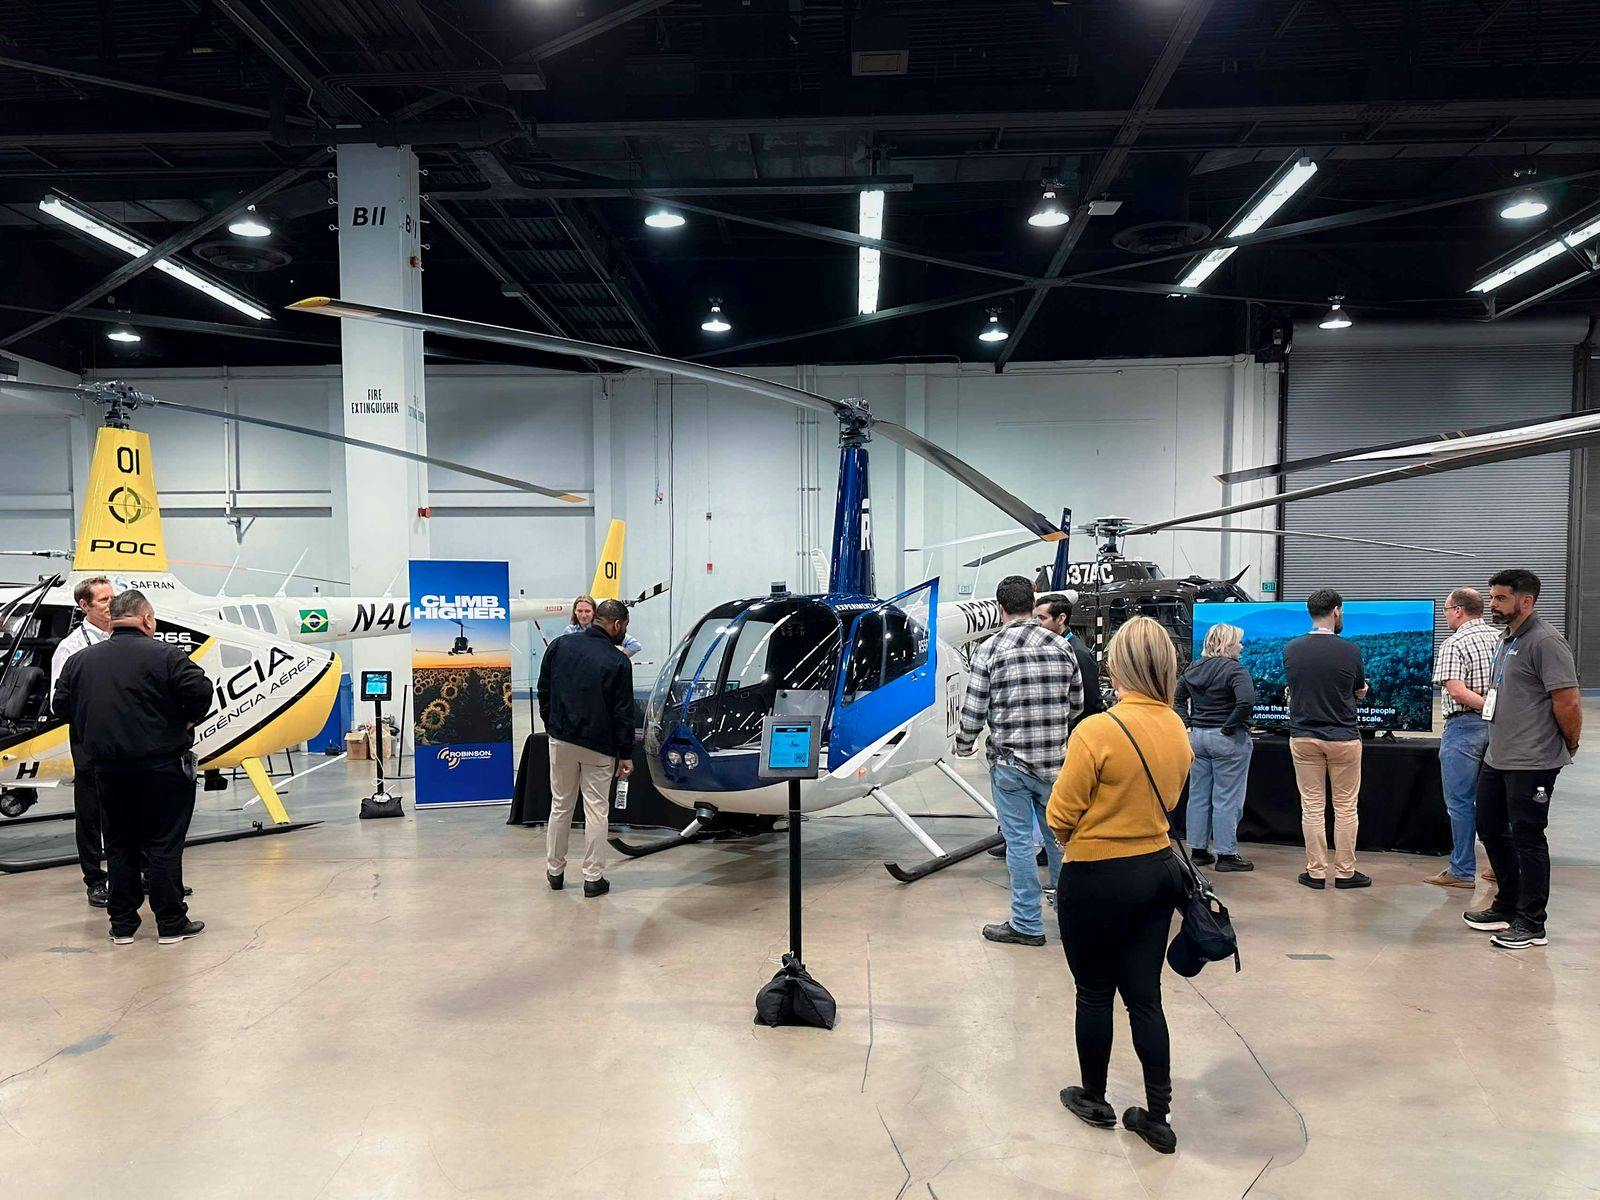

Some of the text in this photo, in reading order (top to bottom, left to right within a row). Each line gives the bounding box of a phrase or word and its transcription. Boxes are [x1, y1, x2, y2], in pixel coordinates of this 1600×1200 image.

[368, 389, 382, 401] FIRE
[352, 402, 399, 414] EXTINGUISHER
[90, 539, 157, 556] POC
[131, 580, 175, 590] SAFRAN
[420, 594, 499, 608] CLIMB
[413, 607, 506, 620] HIGHER
[270, 656, 316, 694] AÉREA
